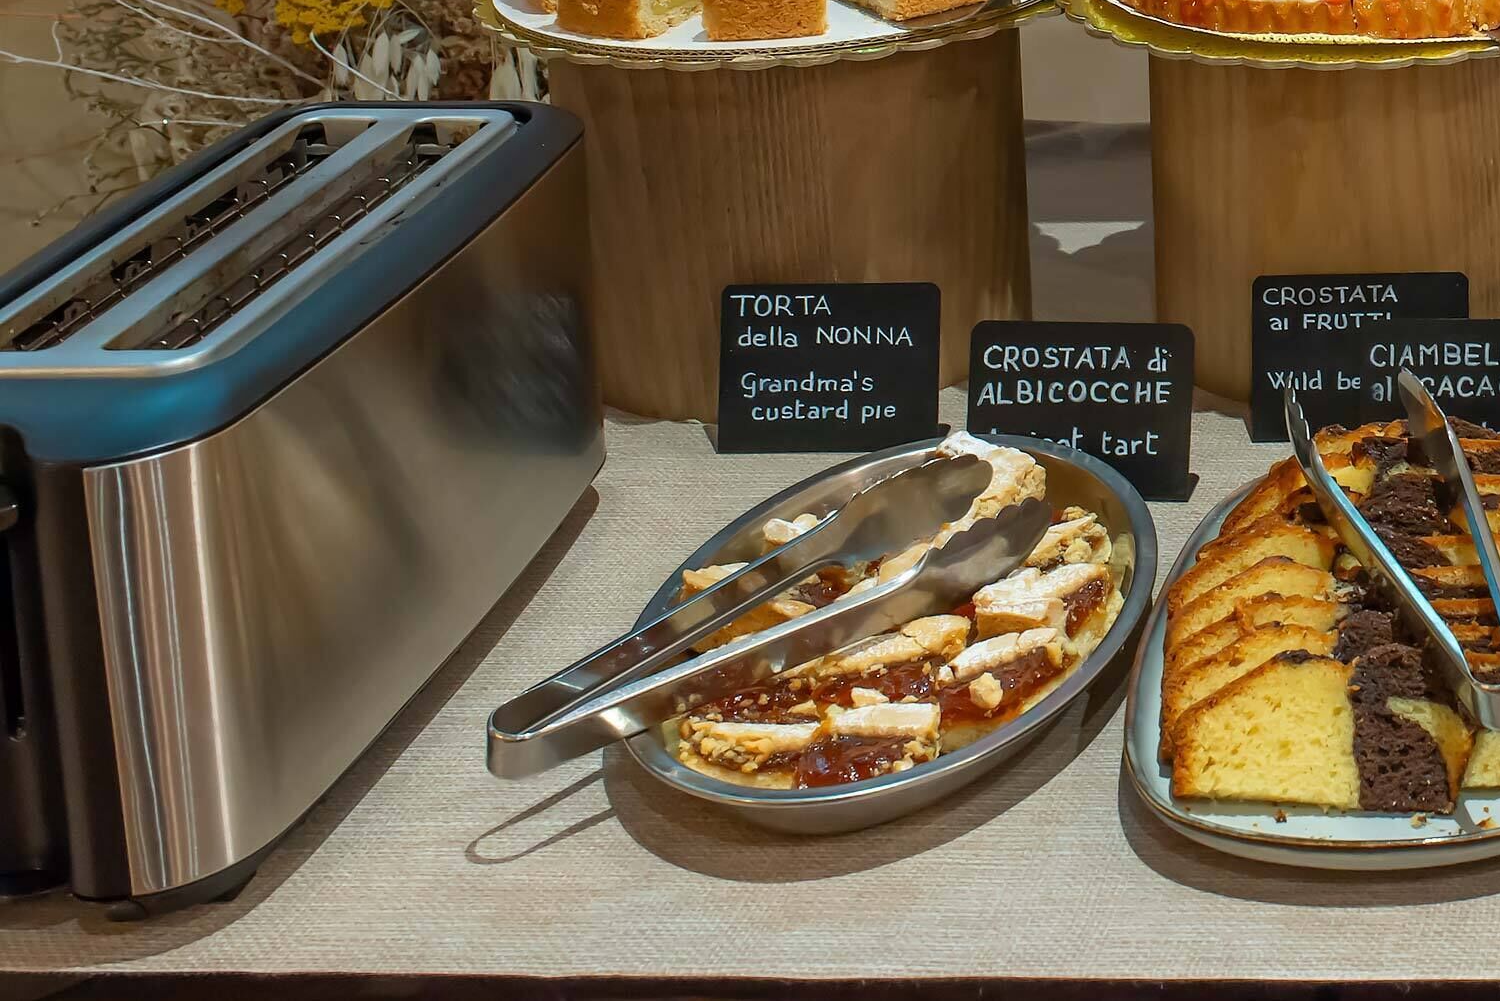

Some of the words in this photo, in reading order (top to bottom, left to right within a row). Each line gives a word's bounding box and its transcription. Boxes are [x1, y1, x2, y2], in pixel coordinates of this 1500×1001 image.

[729, 294, 832, 317] TORTA
[1262, 283, 1400, 306] CROSTATA
[737, 325, 799, 348] della
[815, 325, 914, 347] NONNA
[983, 344, 1131, 373] CROSTATA
[1146, 346, 1170, 373] di
[740, 369, 875, 398] Grandma's
[976, 379, 1173, 407] ALBICOCCHE
[751, 398, 849, 421] custard
[861, 404, 897, 424] pie
[1101, 430, 1160, 456] tart
